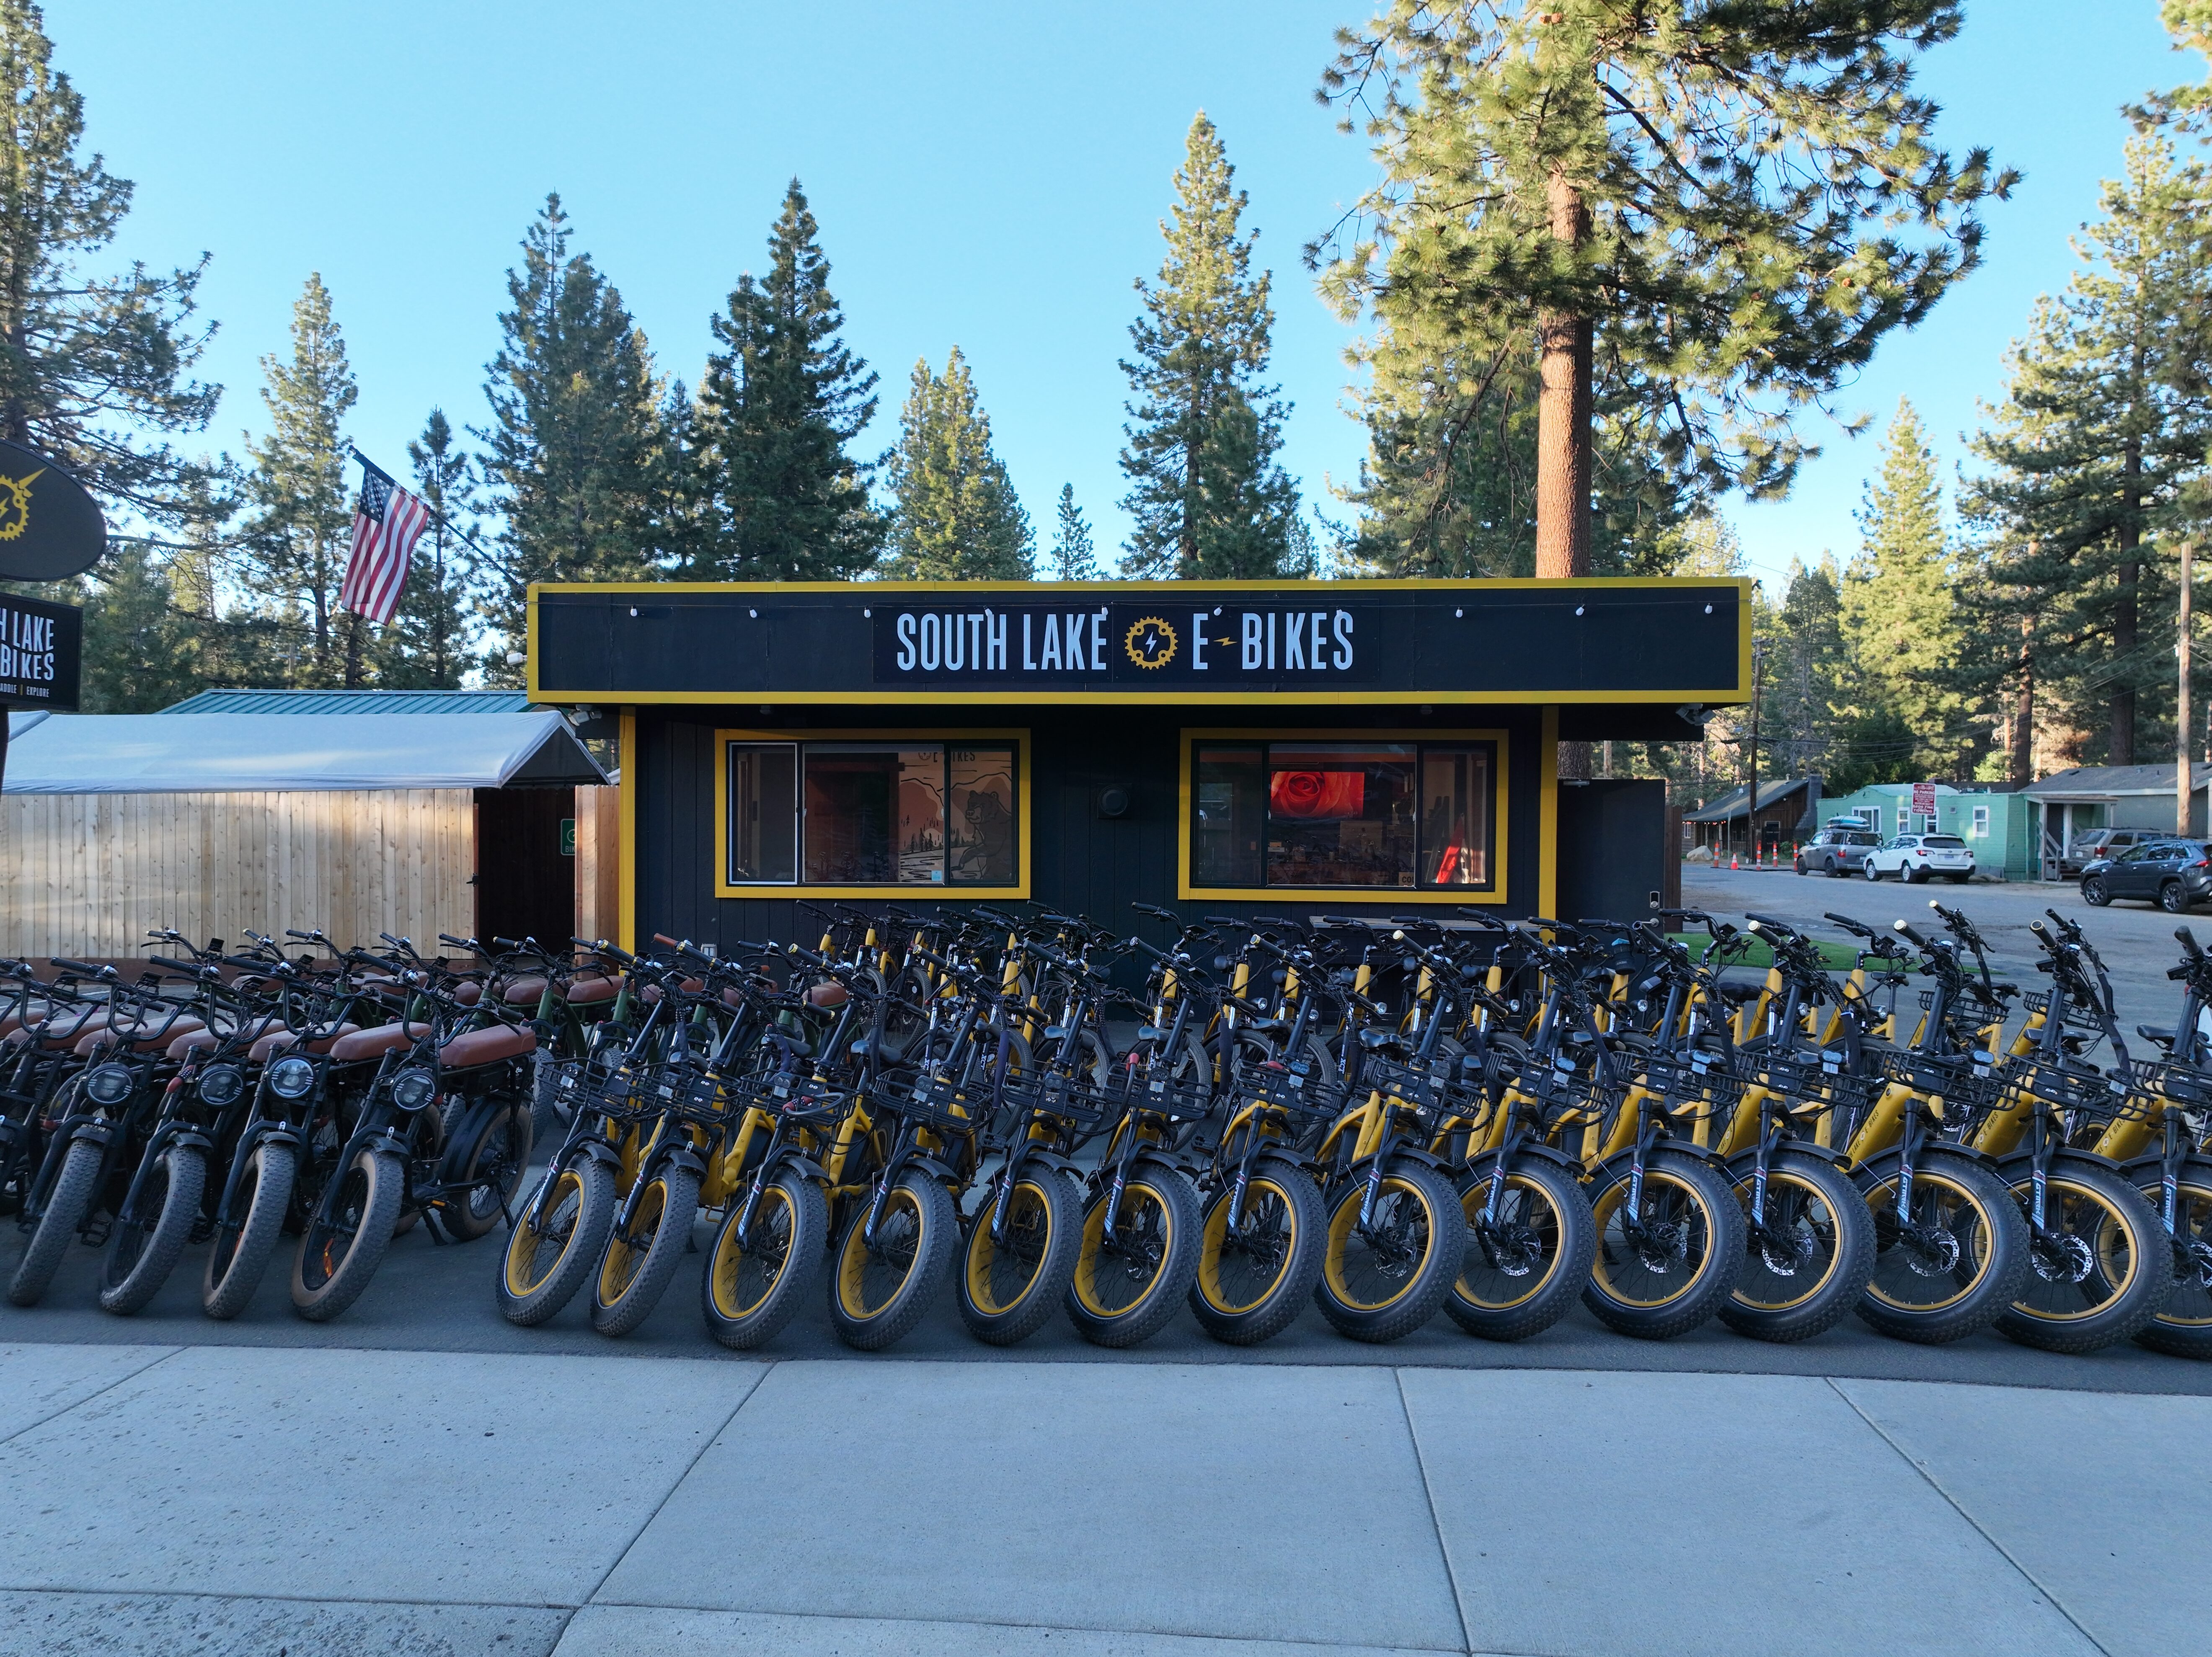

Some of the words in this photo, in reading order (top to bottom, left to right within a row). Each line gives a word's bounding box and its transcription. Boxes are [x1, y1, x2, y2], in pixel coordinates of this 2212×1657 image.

[13, 611, 54, 652] LAKE
[897, 613, 1006, 671] SOUTH
[1023, 613, 1107, 671] LAKE
[1193, 613, 1208, 670] E
[1242, 611, 1353, 670] BIKES
[0, 643, 54, 681] BIKES
[0, 683, 17, 694] ADDLE
[26, 686, 49, 697] EXPLORE
[953, 752, 975, 762] IKES
[1987, 1112, 1998, 1130] BIKES
